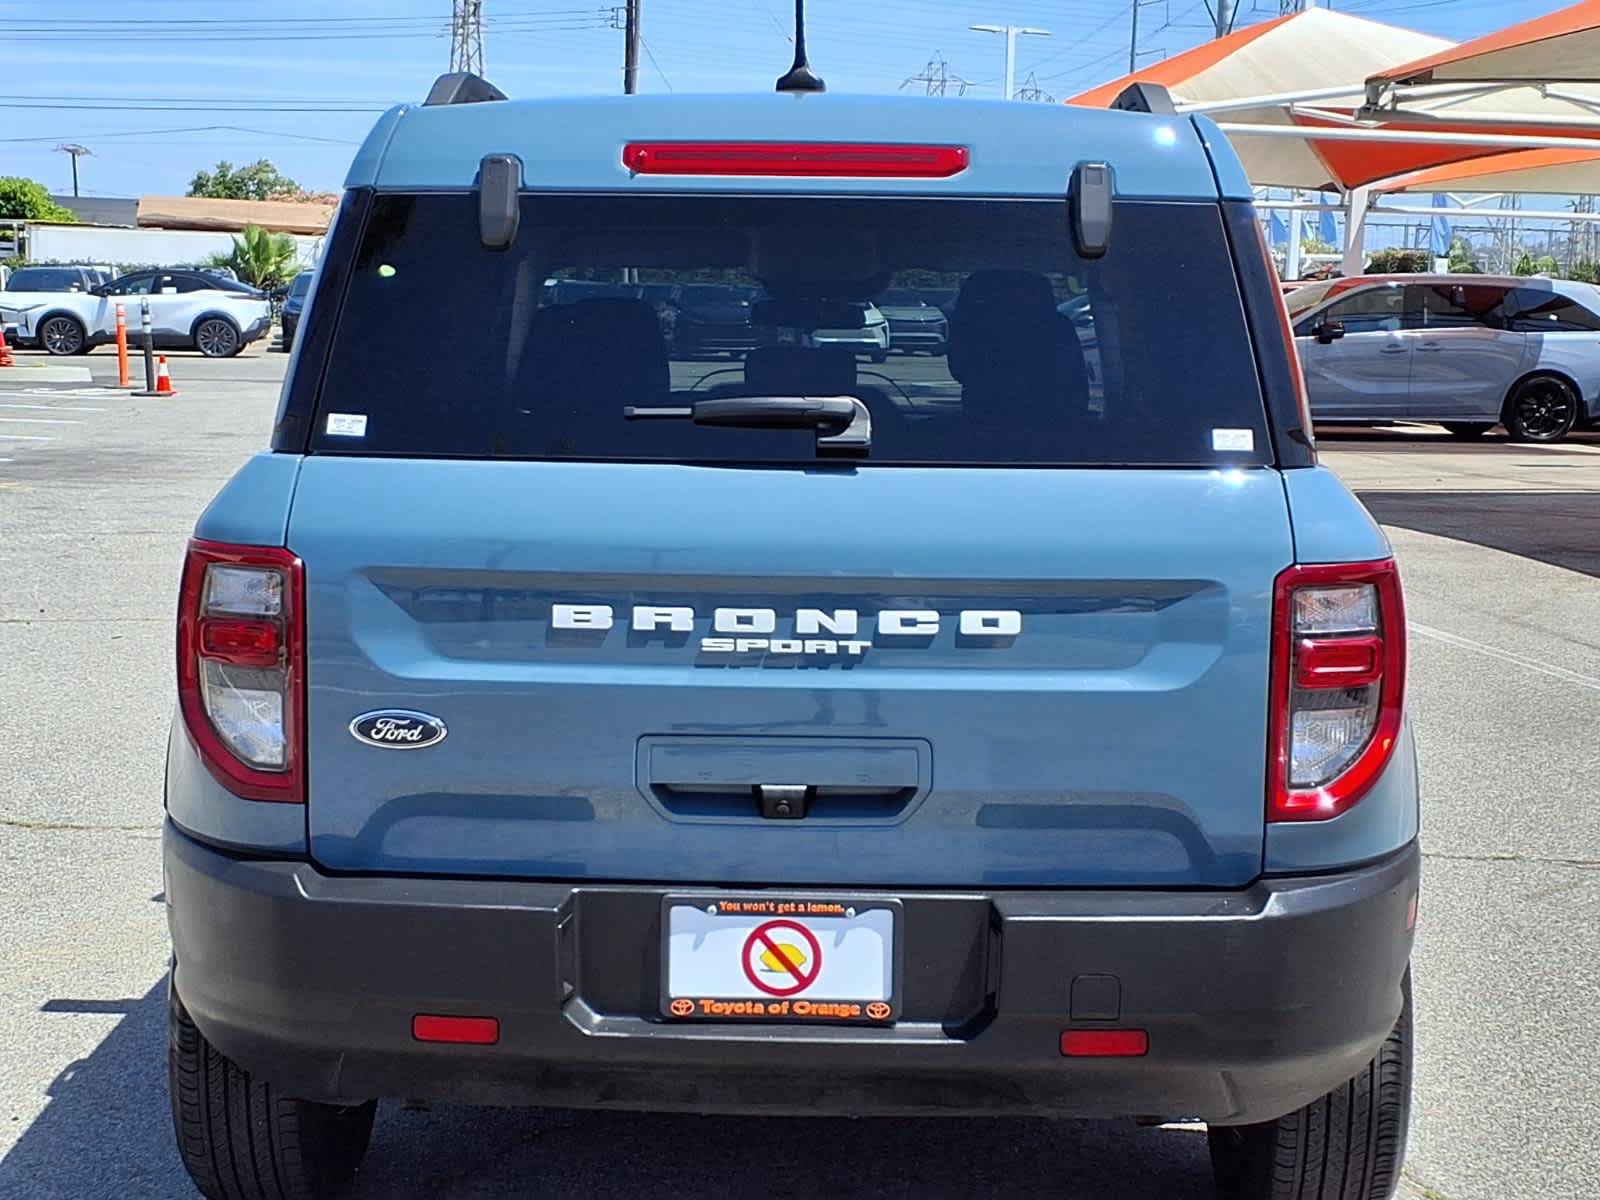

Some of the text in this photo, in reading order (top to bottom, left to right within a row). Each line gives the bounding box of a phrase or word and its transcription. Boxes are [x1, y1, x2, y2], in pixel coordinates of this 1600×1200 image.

[552, 604, 1022, 635] BRONCO
[701, 638, 872, 655] SPORT
[371, 718, 424, 741] Ford
[719, 901, 741, 912] You
[743, 901, 775, 912] won't
[777, 902, 796, 914] get
[797, 904, 806, 913] a
[699, 1000, 861, 1017] Toyota of Orange
